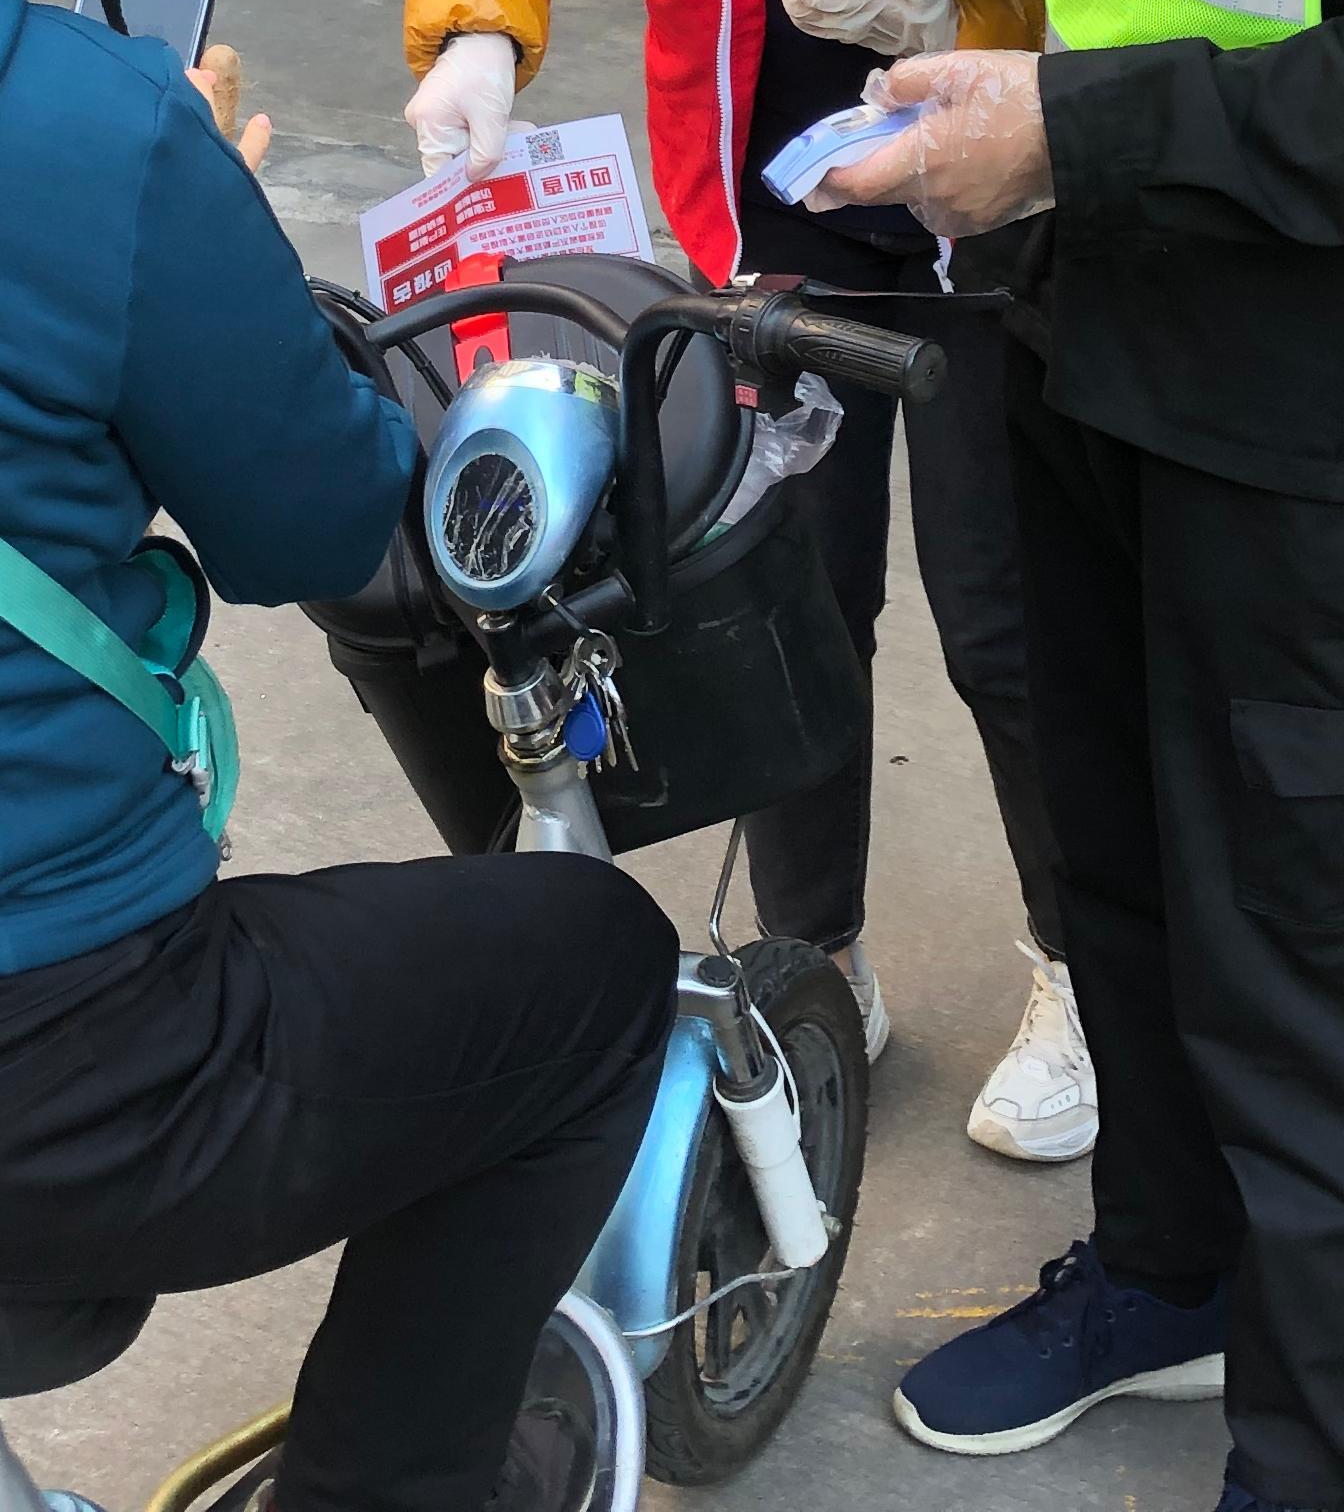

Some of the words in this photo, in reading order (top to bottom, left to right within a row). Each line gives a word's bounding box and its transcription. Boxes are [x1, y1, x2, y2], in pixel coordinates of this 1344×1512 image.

[540, 166, 613, 197] 四必查
[391, 258, 453, 306] 四报告
